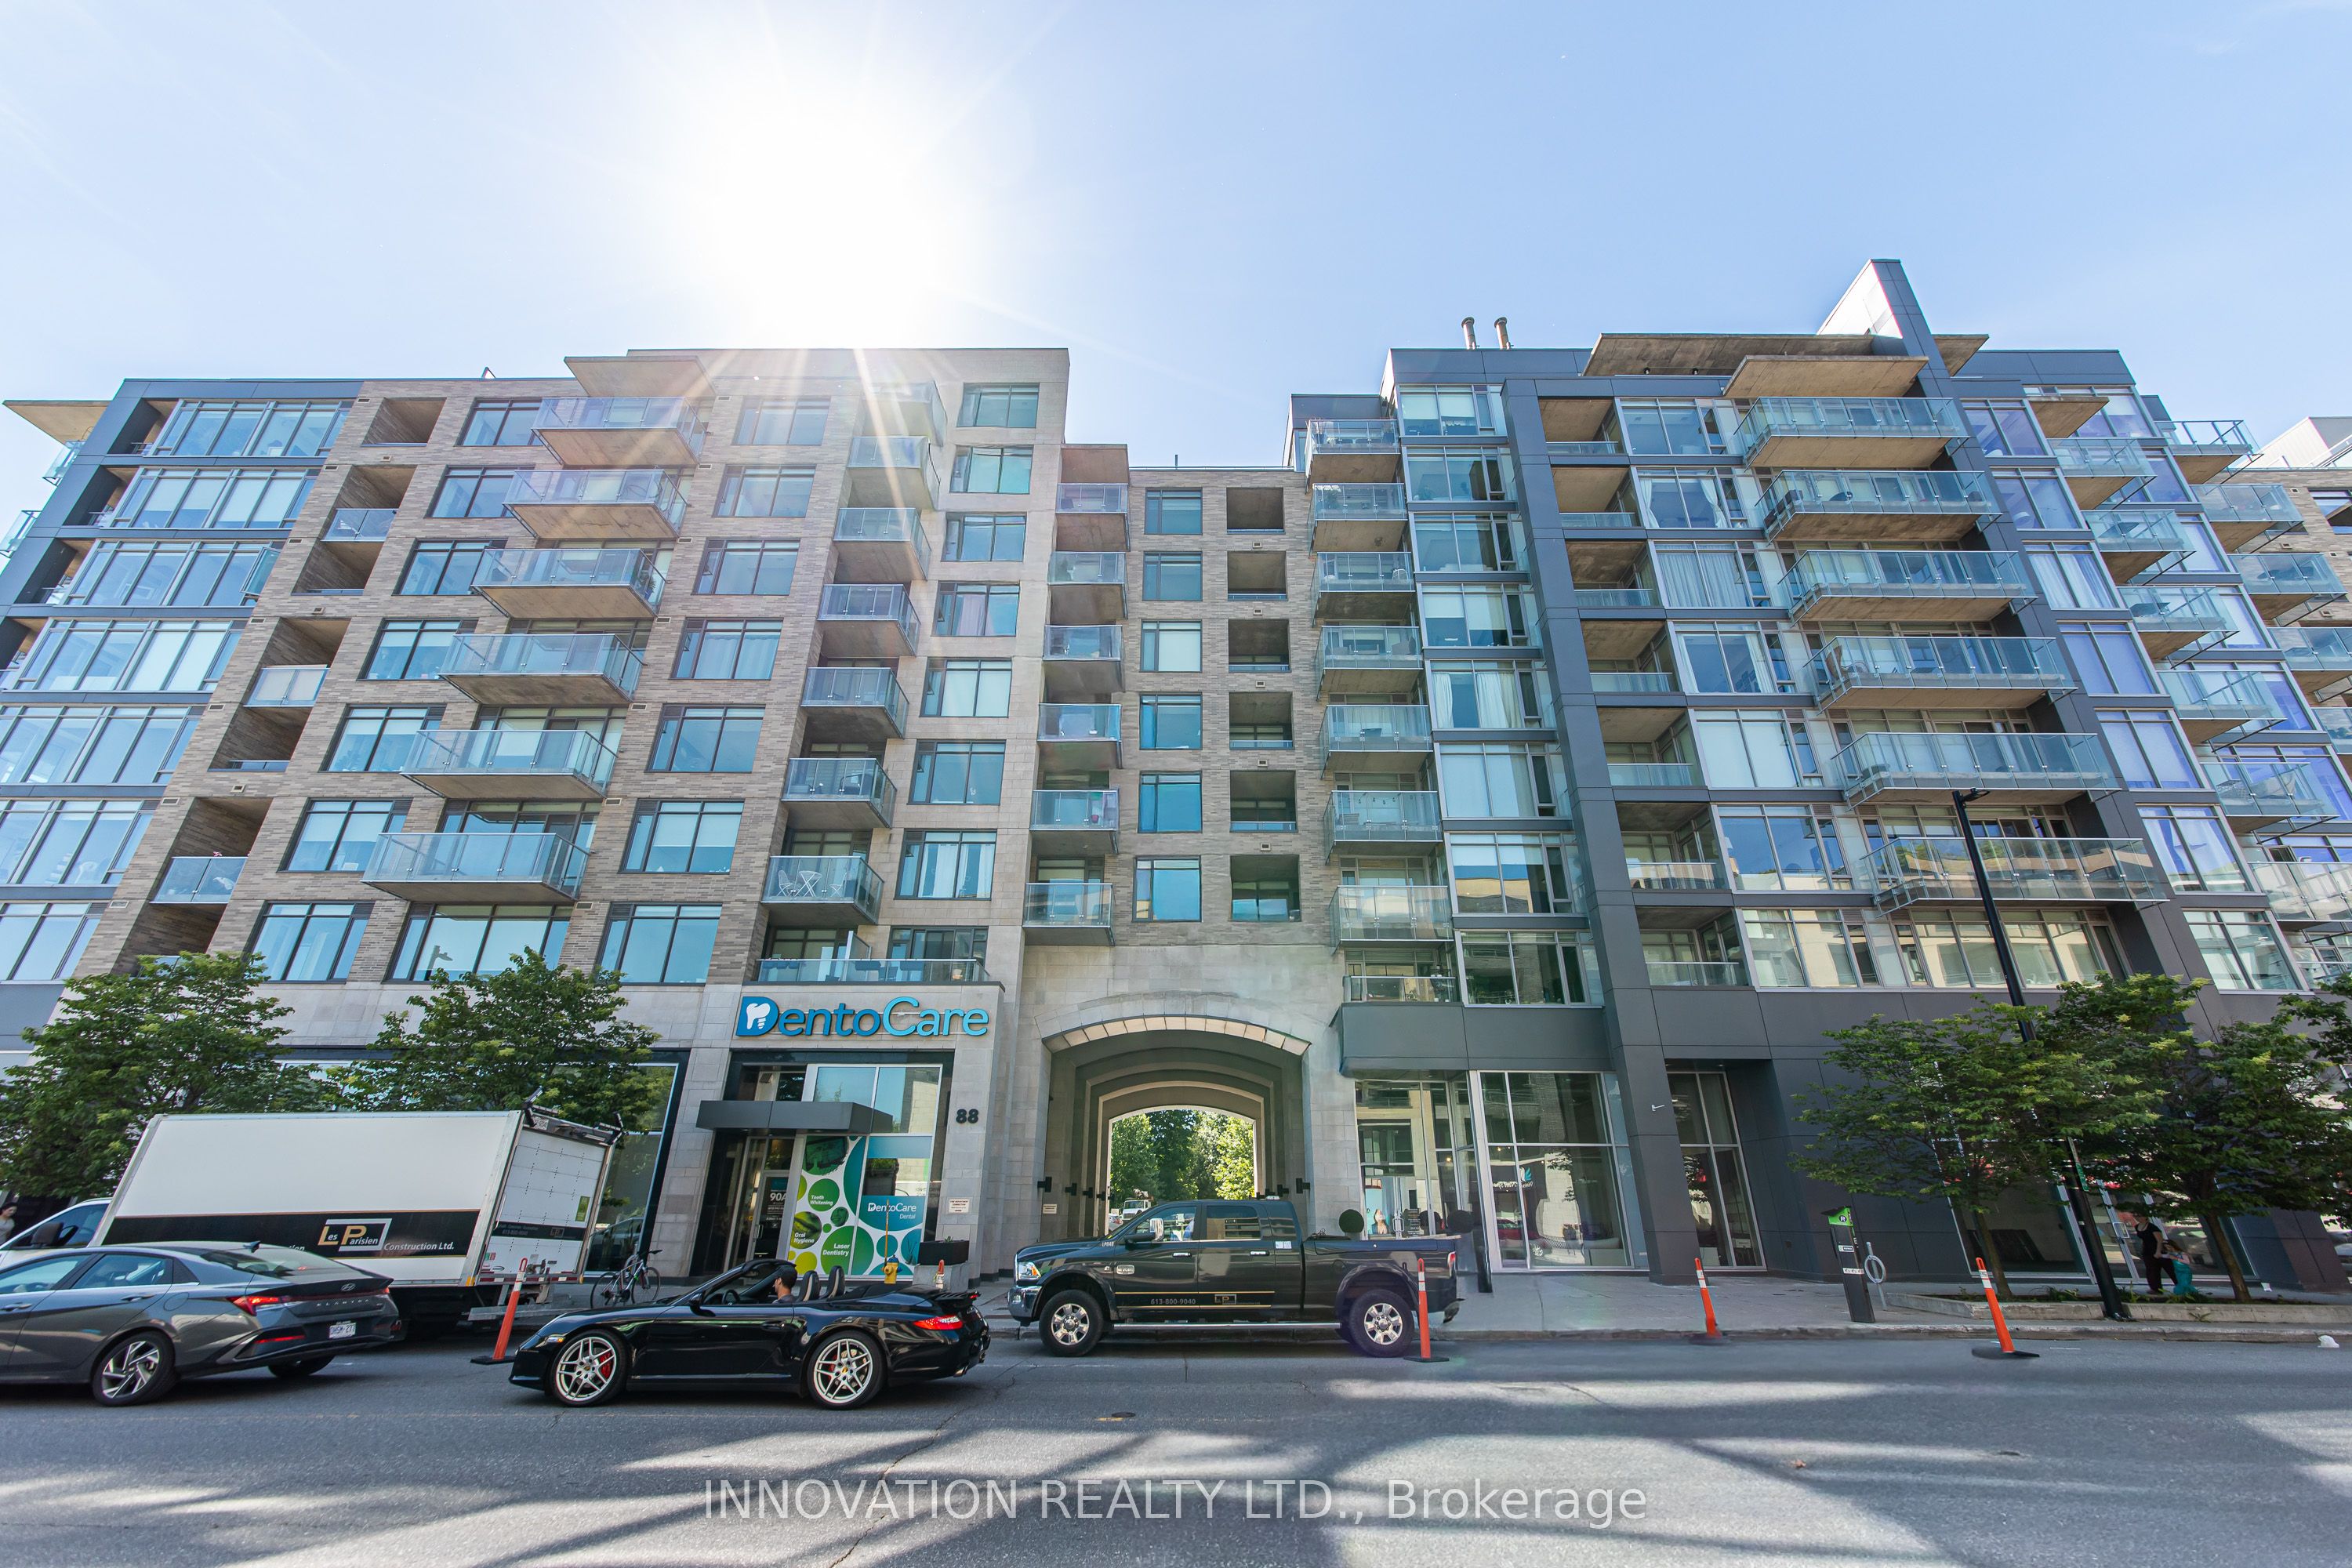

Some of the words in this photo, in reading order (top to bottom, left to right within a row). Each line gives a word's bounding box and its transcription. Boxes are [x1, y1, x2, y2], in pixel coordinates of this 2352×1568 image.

[735, 996, 989, 1037] DentoCare
[956, 1109, 979, 1123] 88
[383, 1243, 437, 1251] Construction
[438, 1241, 455, 1250] Ltd.
